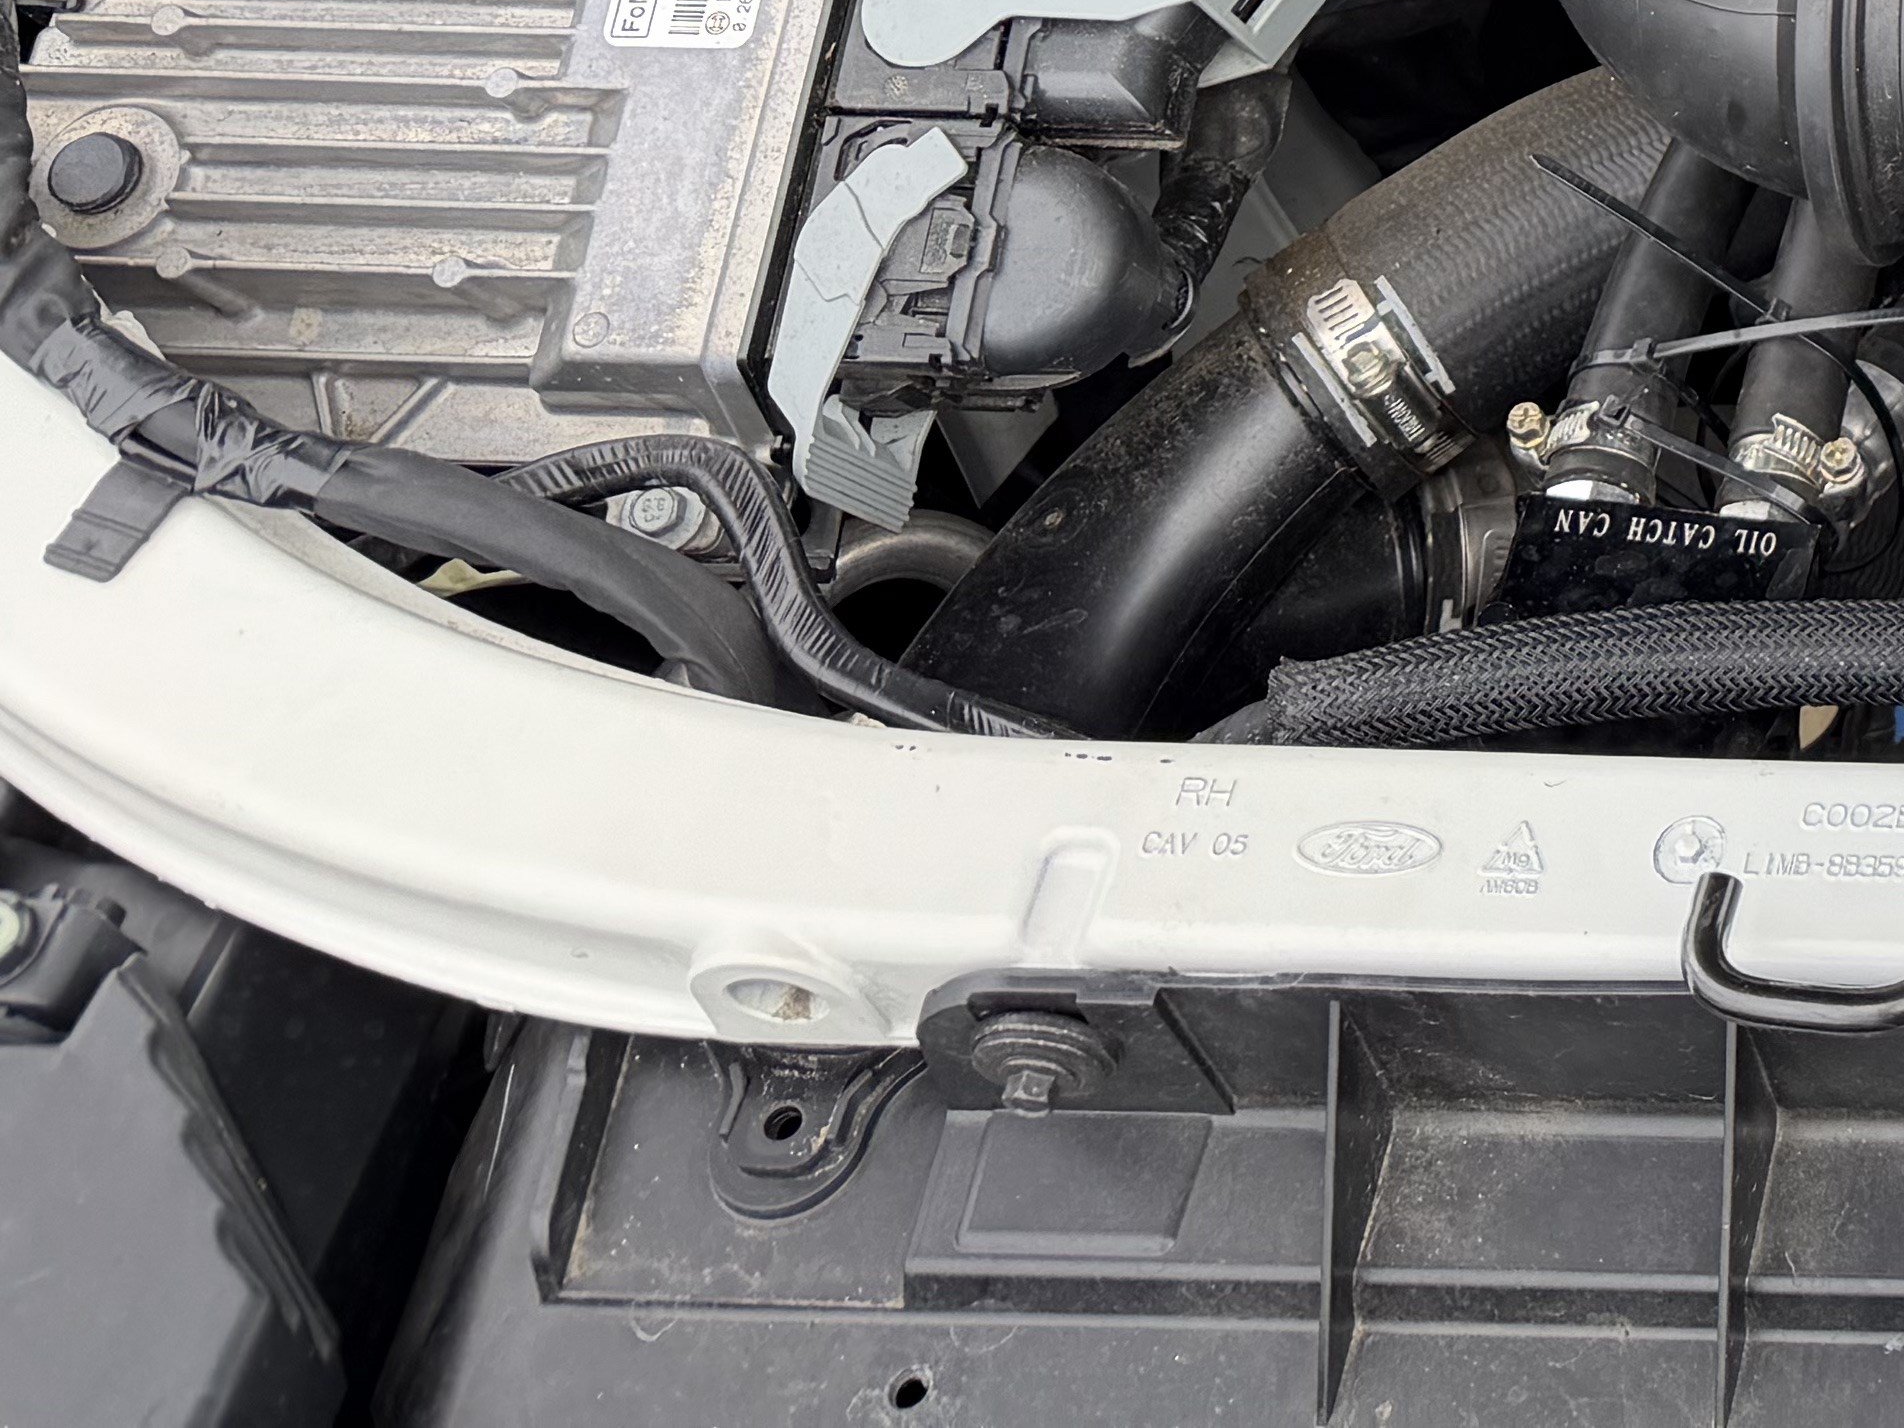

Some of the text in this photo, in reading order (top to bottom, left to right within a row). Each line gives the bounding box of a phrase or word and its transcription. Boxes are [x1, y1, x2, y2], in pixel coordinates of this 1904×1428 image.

[1553, 507, 1779, 557] OIL CATCH CAN
[1174, 776, 1239, 808] RH
[1140, 830, 1250, 858] CAV 05
[1320, 829, 1418, 871] Ford
